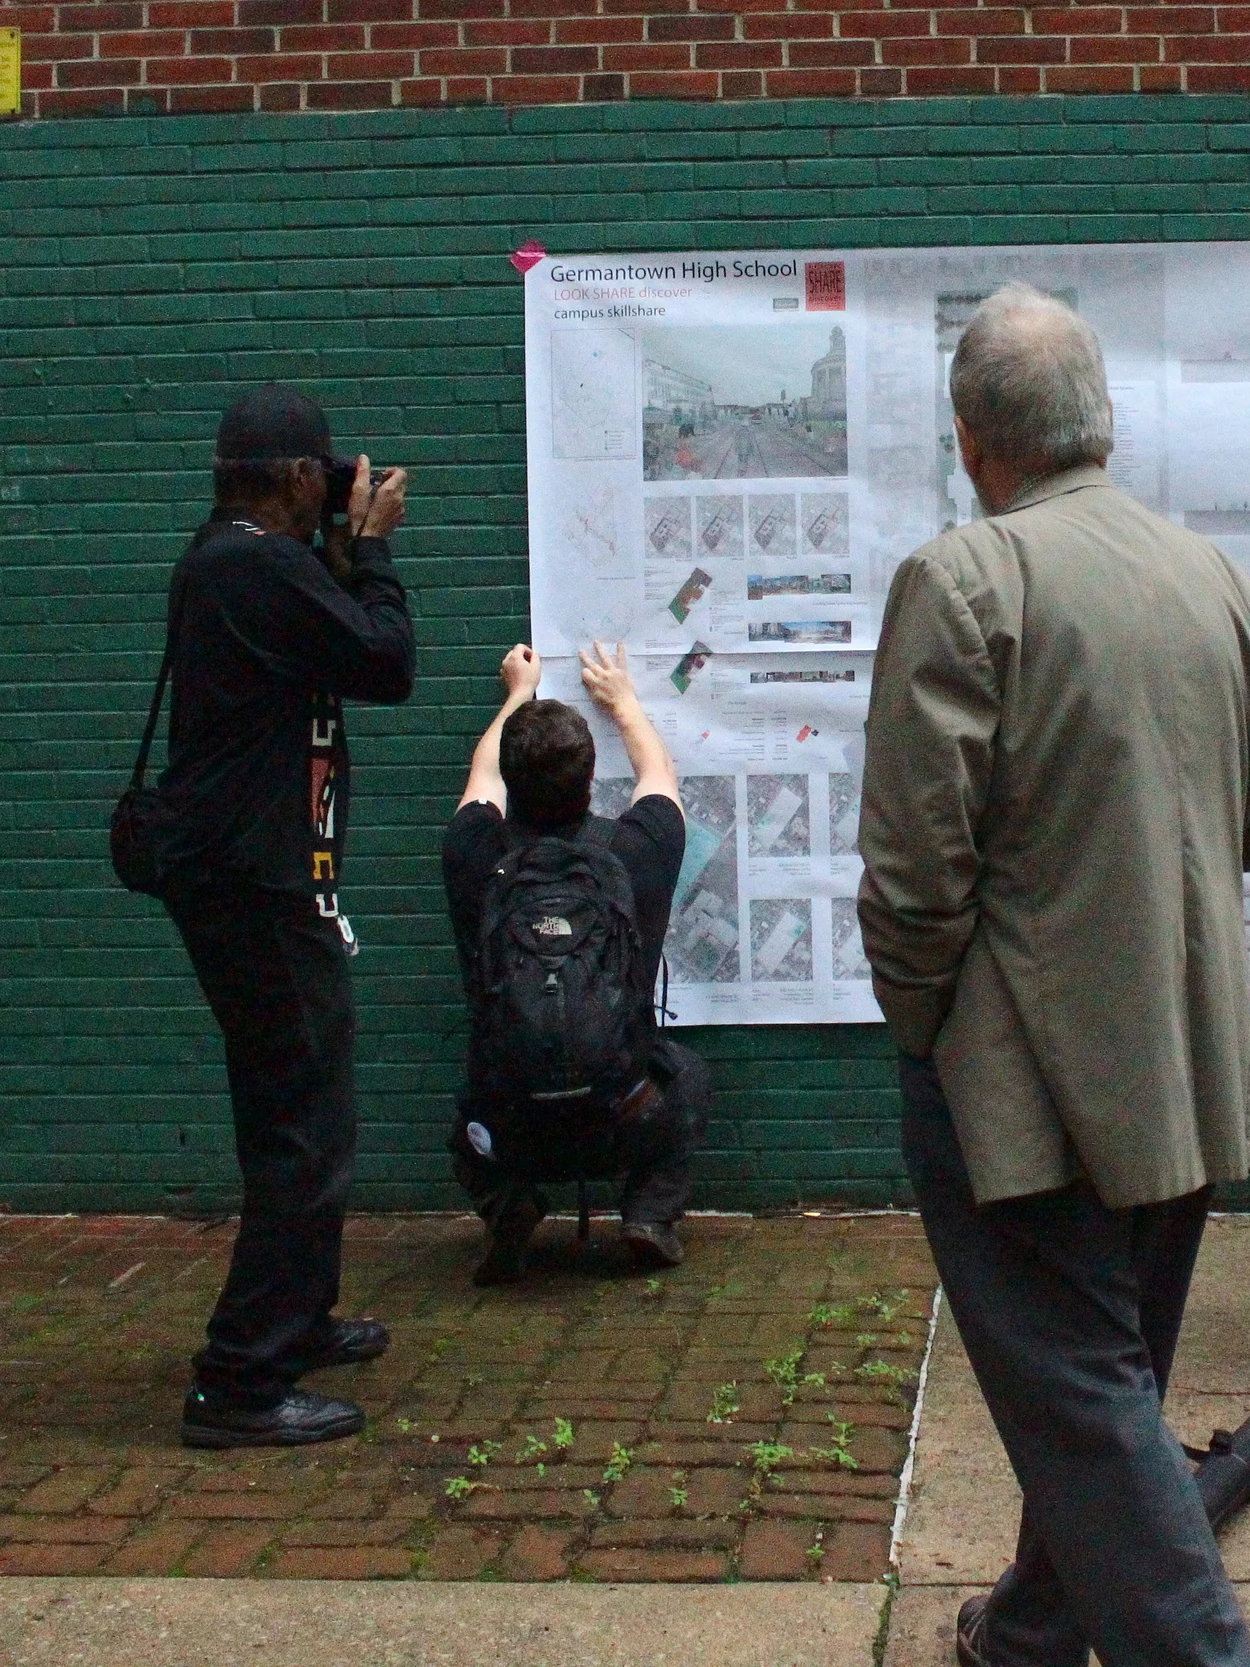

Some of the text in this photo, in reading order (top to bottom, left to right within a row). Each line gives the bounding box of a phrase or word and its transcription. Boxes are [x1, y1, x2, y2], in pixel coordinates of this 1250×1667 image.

[551, 259, 797, 283] Germantown High School
[808, 270, 842, 293] SHARE
[554, 286, 693, 301] LOOK SHARE discover
[554, 305, 667, 321] campus skillshare
